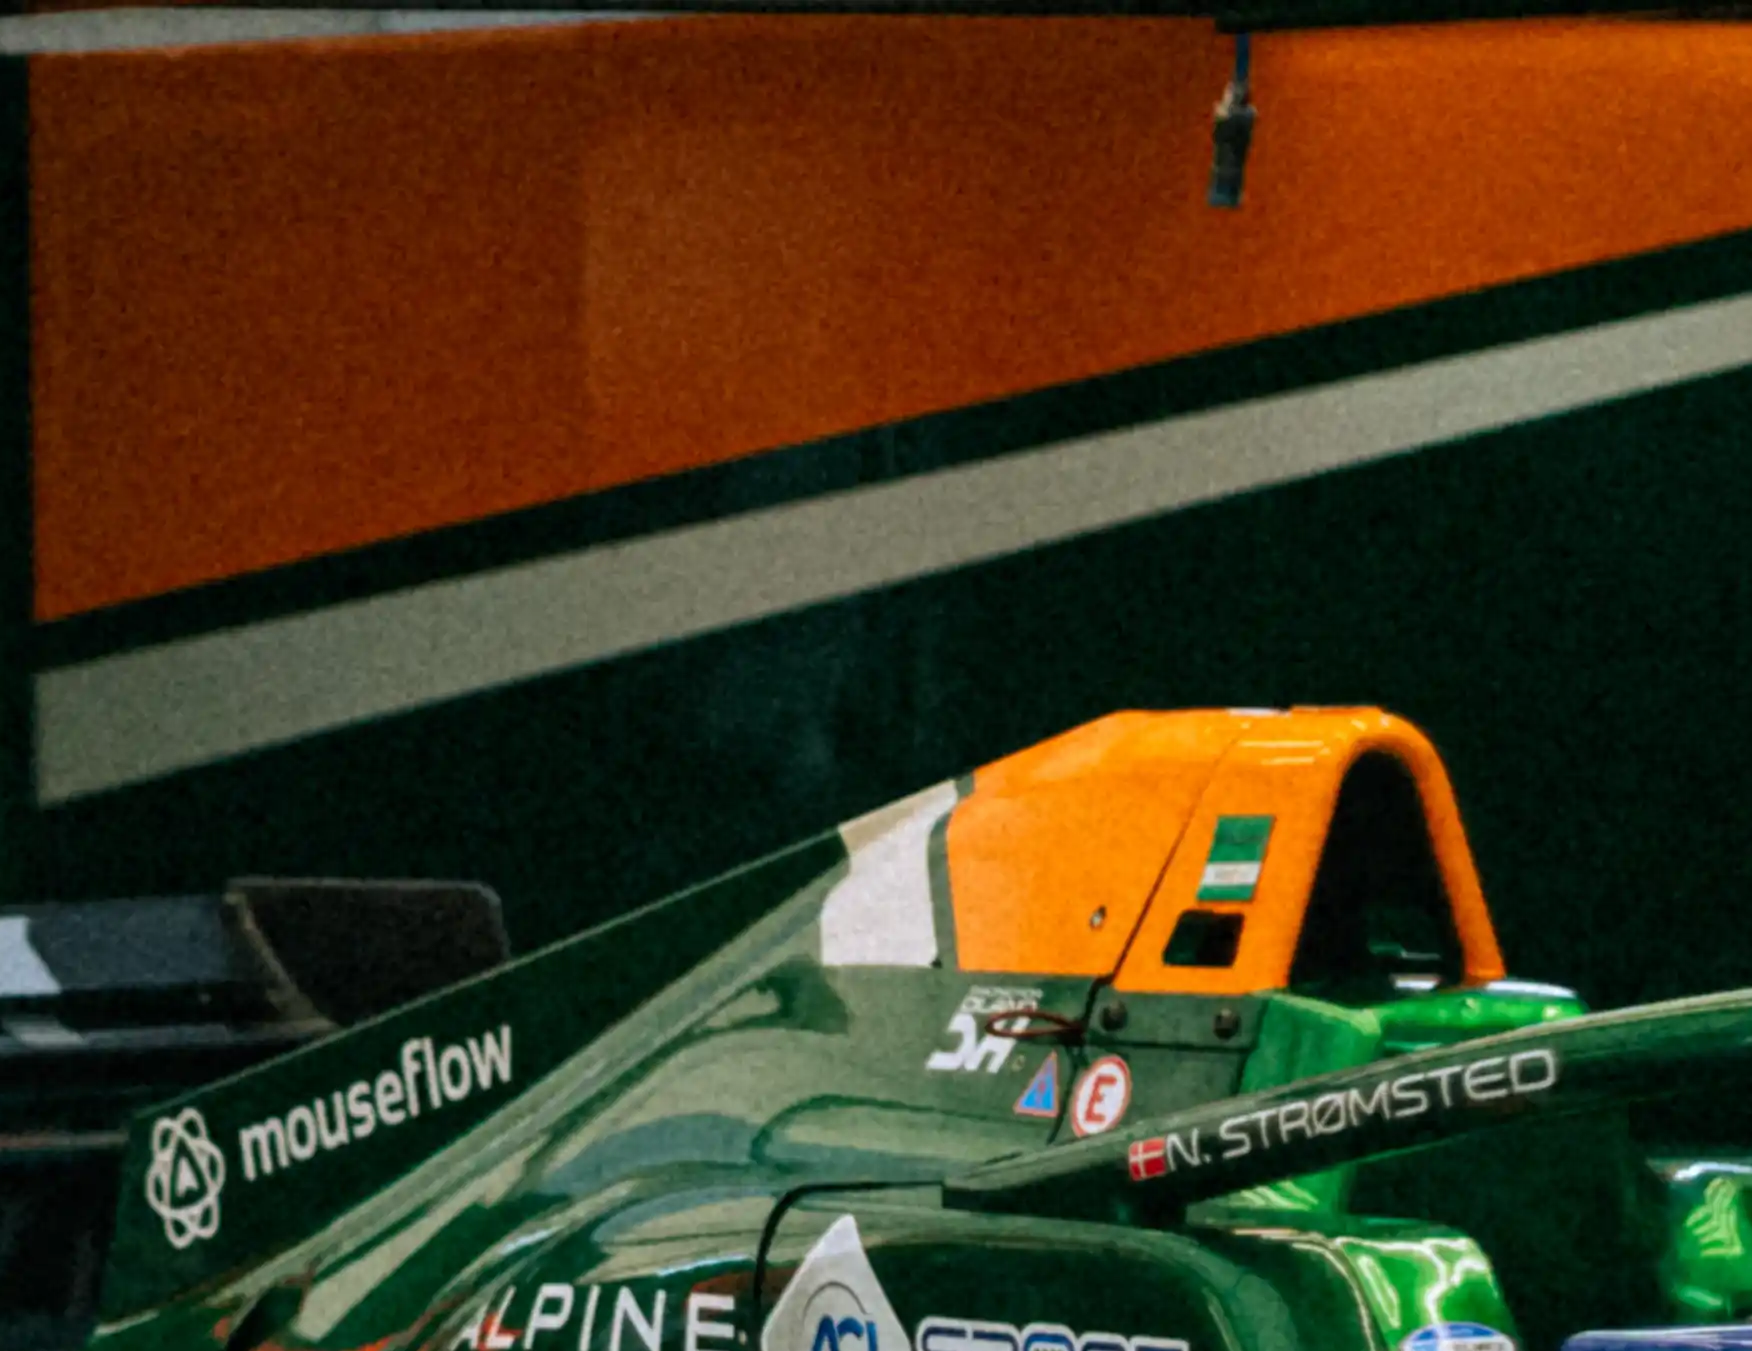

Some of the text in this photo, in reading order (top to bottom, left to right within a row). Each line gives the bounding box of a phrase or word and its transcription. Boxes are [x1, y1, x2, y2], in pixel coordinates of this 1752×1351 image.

[239, 1023, 514, 1181] mouseflow
[1084, 1075, 1117, 1123] E
[1220, 1047, 1559, 1160] STRØMSTED
